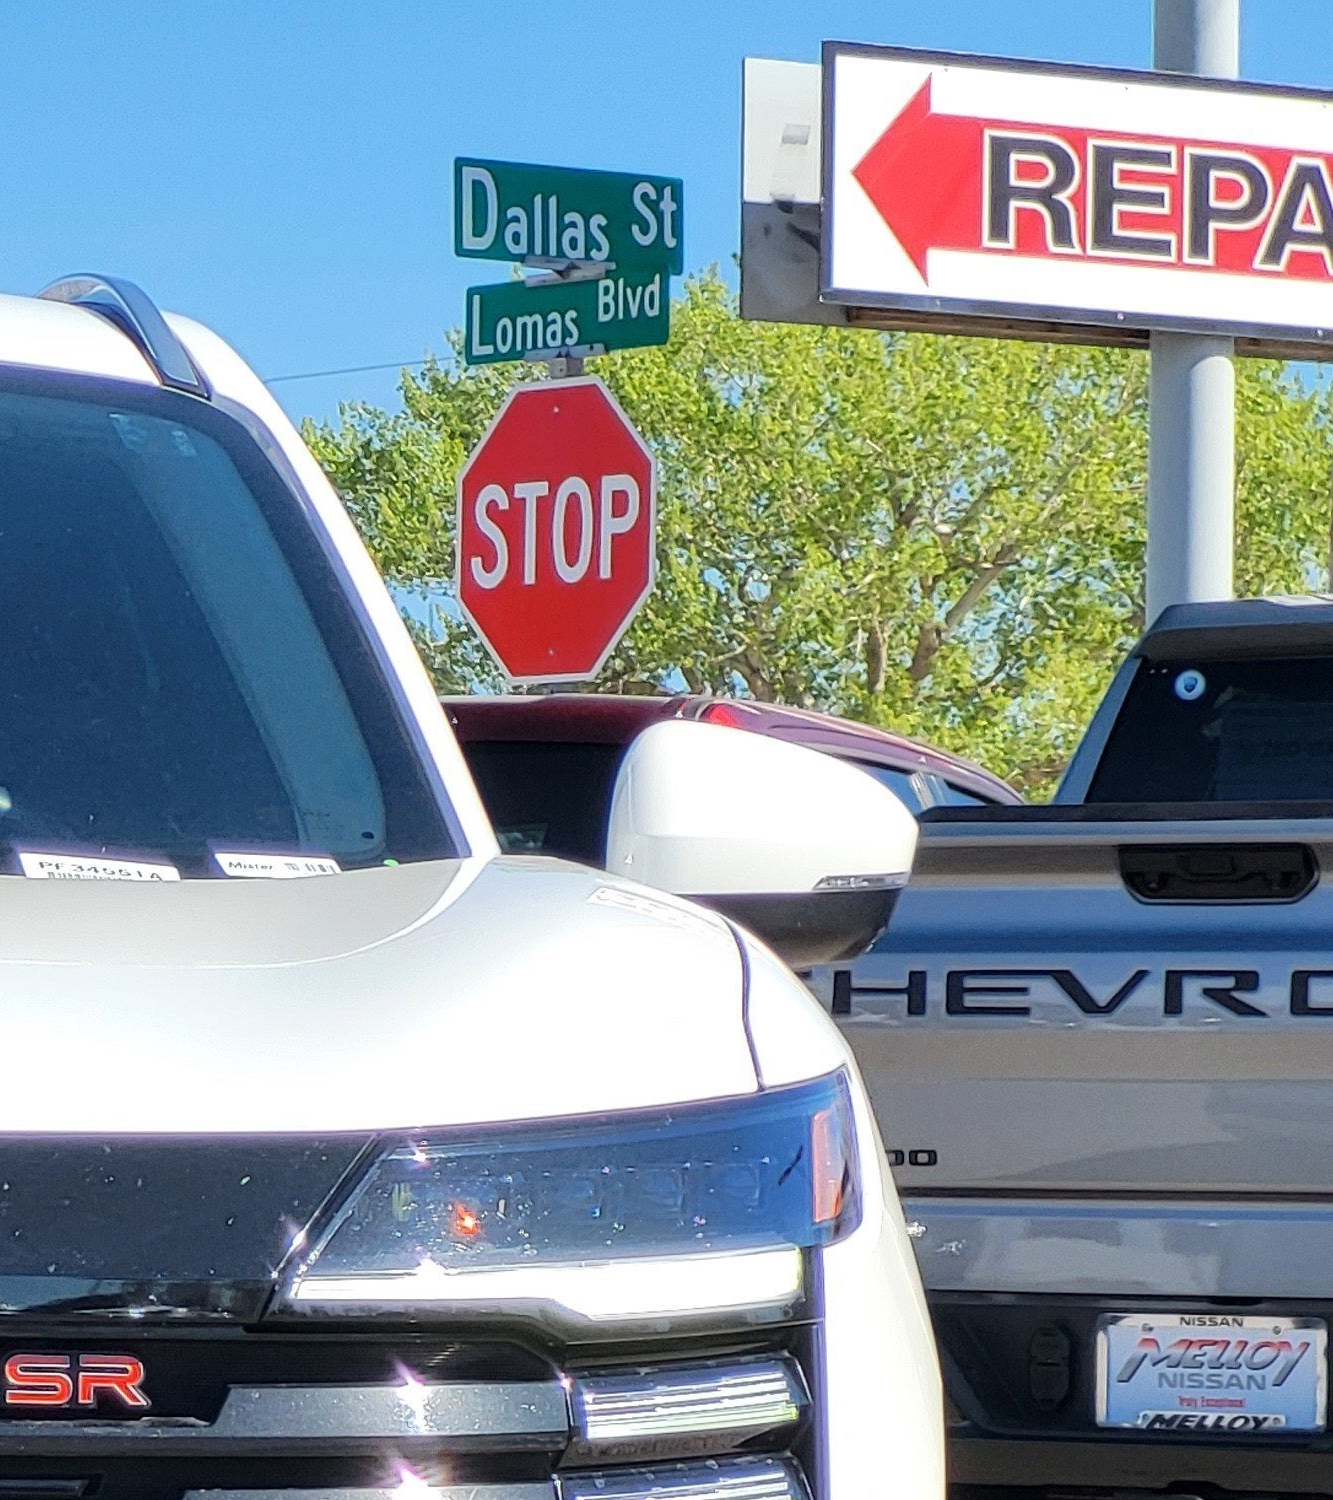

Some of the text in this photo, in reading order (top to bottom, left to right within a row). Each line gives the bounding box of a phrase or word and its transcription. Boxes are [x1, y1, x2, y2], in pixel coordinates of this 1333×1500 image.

[462, 166, 678, 261] Dallas St
[981, 128, 1333, 276] REPA
[472, 273, 661, 356] Lomas Blvd
[470, 475, 641, 591] STOP
[1180, 1316, 1244, 1328] NISSAN
[4, 1353, 150, 1407] SR
[1117, 1337, 1310, 1386] MELLOY
[1158, 1372, 1267, 1391] NISSAN
[1145, 1414, 1269, 1430] MELLOY
